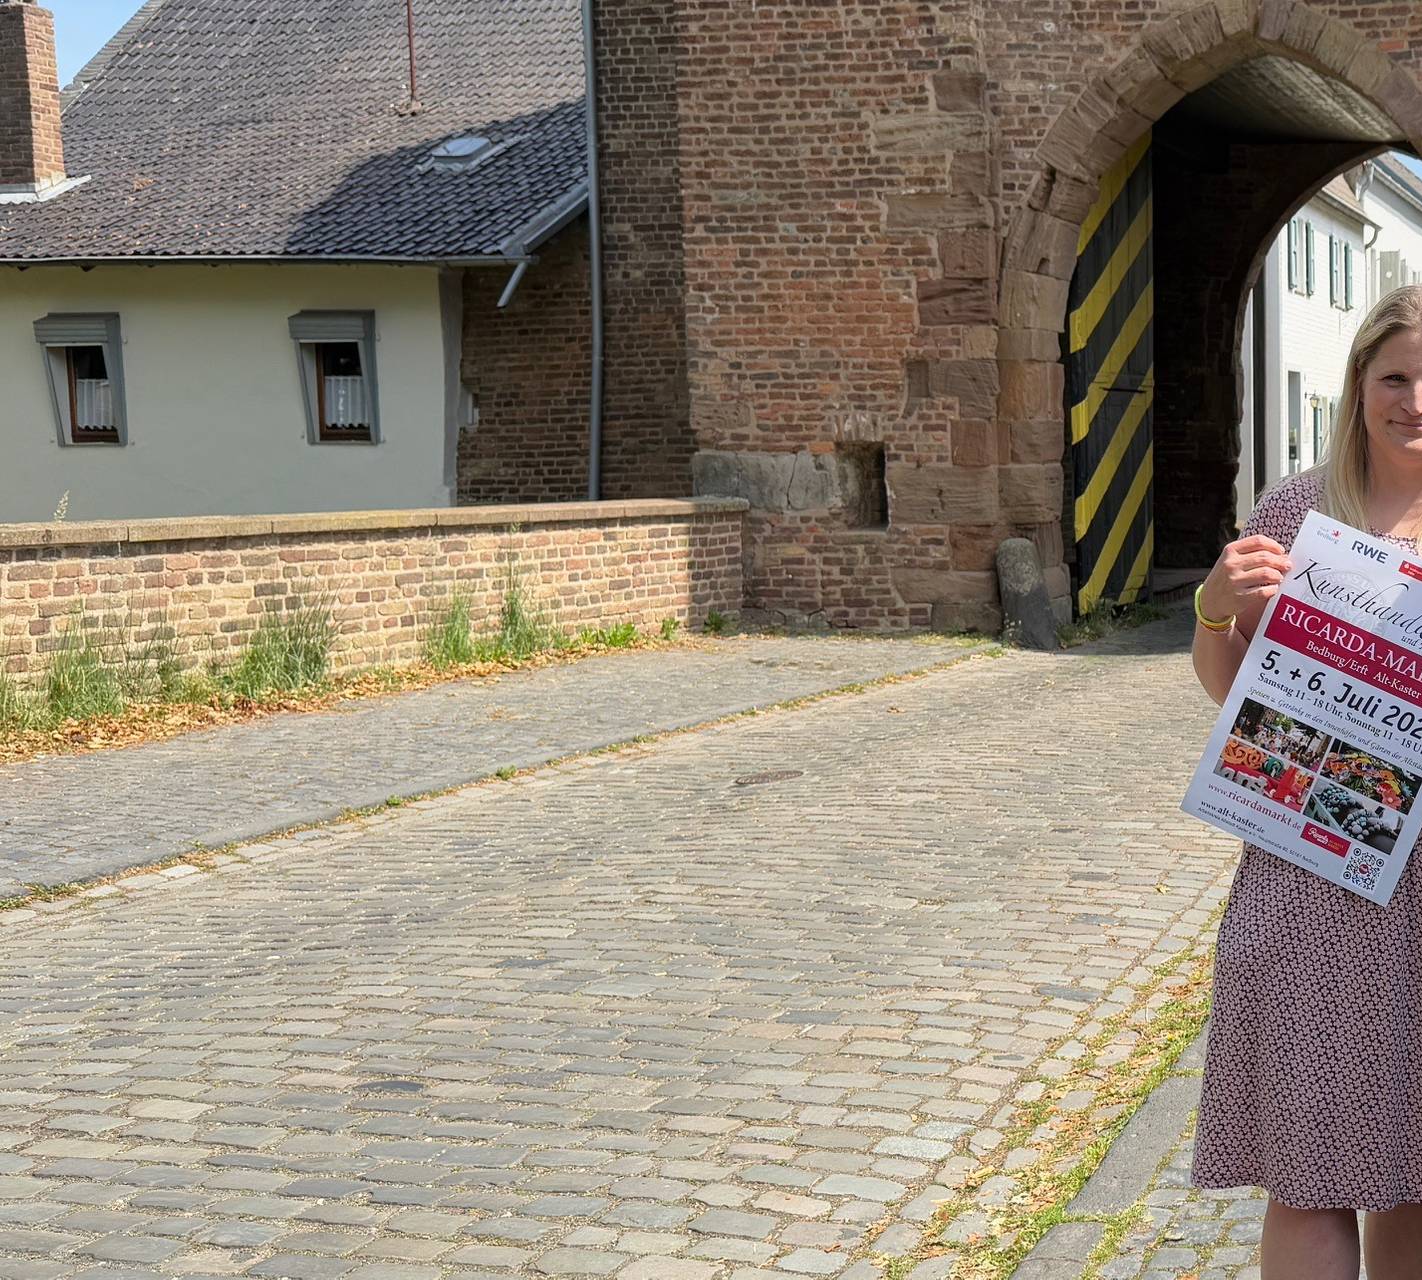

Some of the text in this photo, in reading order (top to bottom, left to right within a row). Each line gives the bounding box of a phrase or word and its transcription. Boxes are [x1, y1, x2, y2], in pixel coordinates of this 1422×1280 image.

[1351, 540, 1389, 564] RWE
[1400, 631, 1420, 647] und
[1260, 649, 1281, 675] 5.
[1289, 667, 1302, 680] +
[1307, 671, 1326, 696] 6.
[1333, 682, 1382, 719] Juli
[1305, 639, 1422, 699] Bedburg/Erft Alt-Kaster
[1257, 671, 1294, 698] Samstag
[1295, 689, 1306, 700] 11
[1312, 697, 1324, 708] 18
[1324, 701, 1343, 720] Uhr,
[1344, 711, 1381, 738] Sonntag
[1382, 729, 1393, 740] 11
[1400, 737, 1413, 749] 18
[1311, 715, 1324, 725] den
[1323, 719, 1357, 740] Innenhöfen
[1357, 736, 1371, 746] und
[1369, 741, 1391, 756] Gärten
[1390, 751, 1402, 760] der
[1201, 800, 1265, 833] www.alt-kaster.de
[1208, 783, 1302, 831] www.ricardamarkt.de
